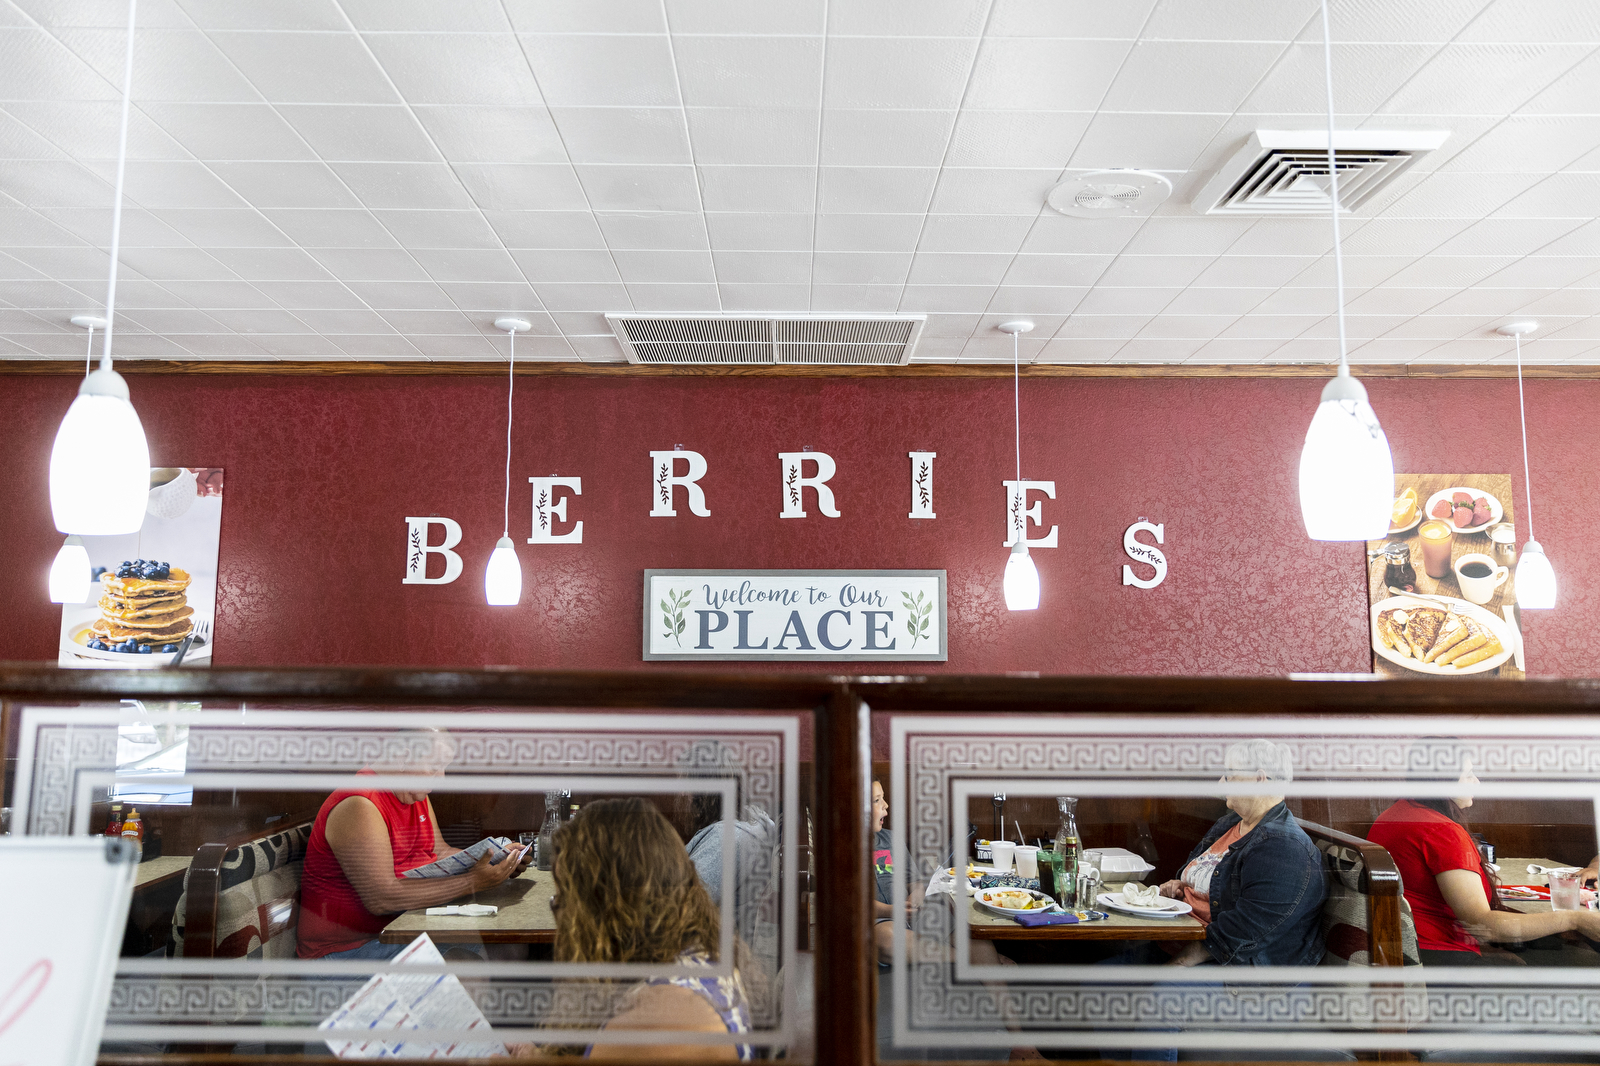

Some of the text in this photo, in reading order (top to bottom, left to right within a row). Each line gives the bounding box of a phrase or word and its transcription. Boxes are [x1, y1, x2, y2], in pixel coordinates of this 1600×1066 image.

[402, 450, 1168, 589] BERRIES
[702, 580, 888, 610] Welcome to Our
[693, 609, 897, 651] PLACE
